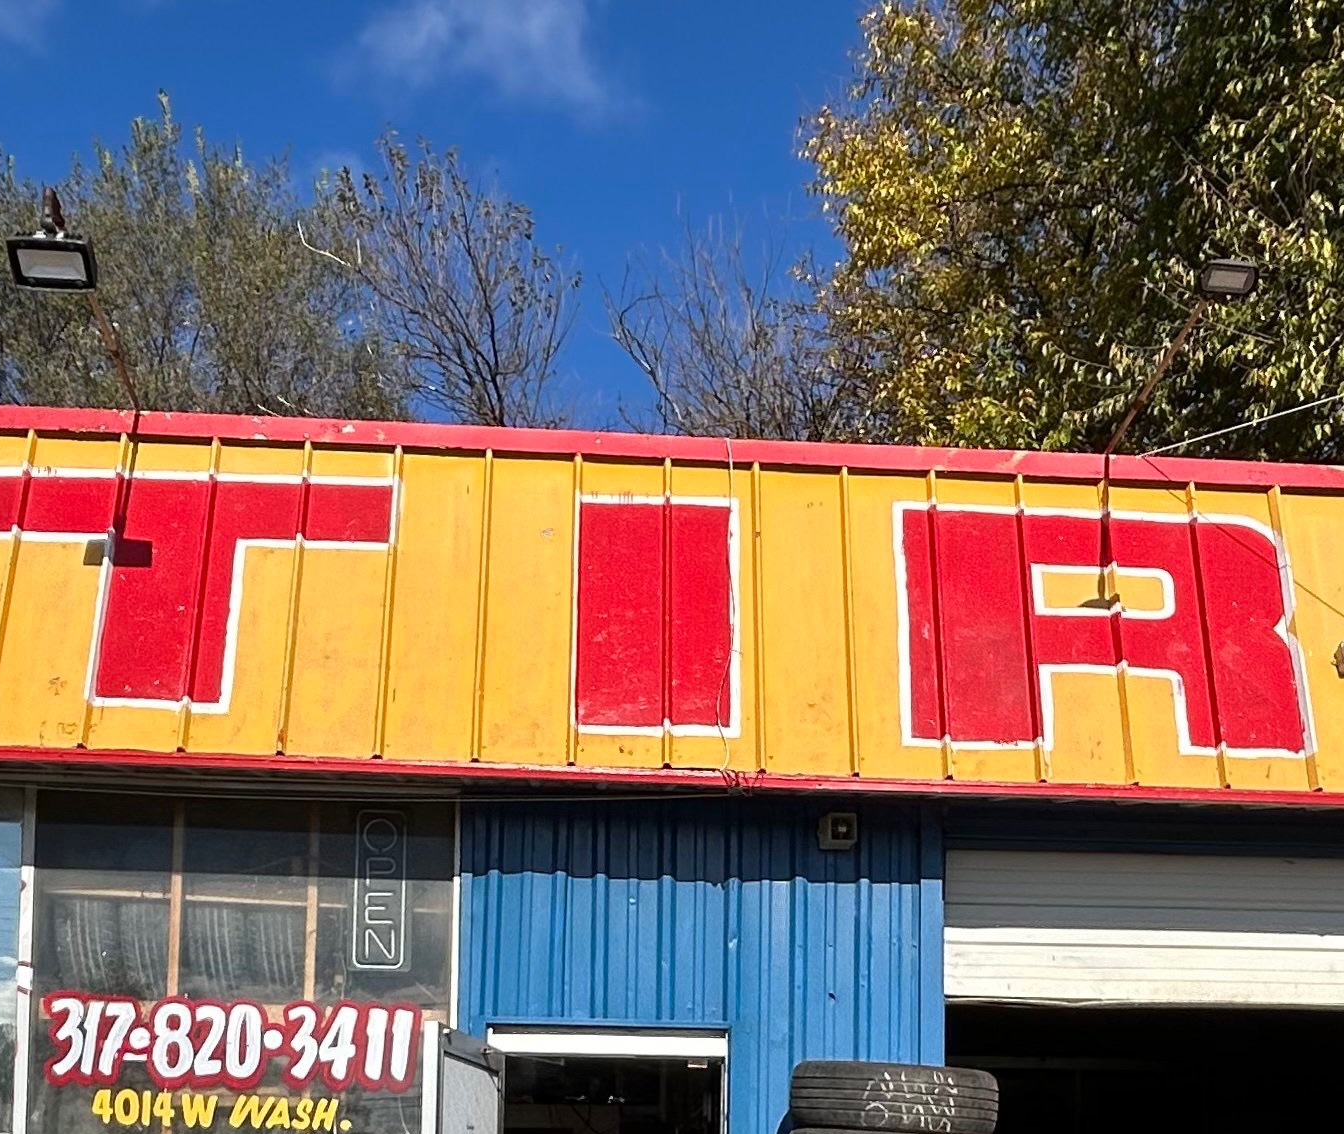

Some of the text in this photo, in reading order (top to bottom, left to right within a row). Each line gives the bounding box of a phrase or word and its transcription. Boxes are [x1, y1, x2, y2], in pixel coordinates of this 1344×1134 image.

[361, 816, 400, 961] OPEN
[91, 1089, 174, 1127] 4014
[182, 1094, 218, 1128] W
